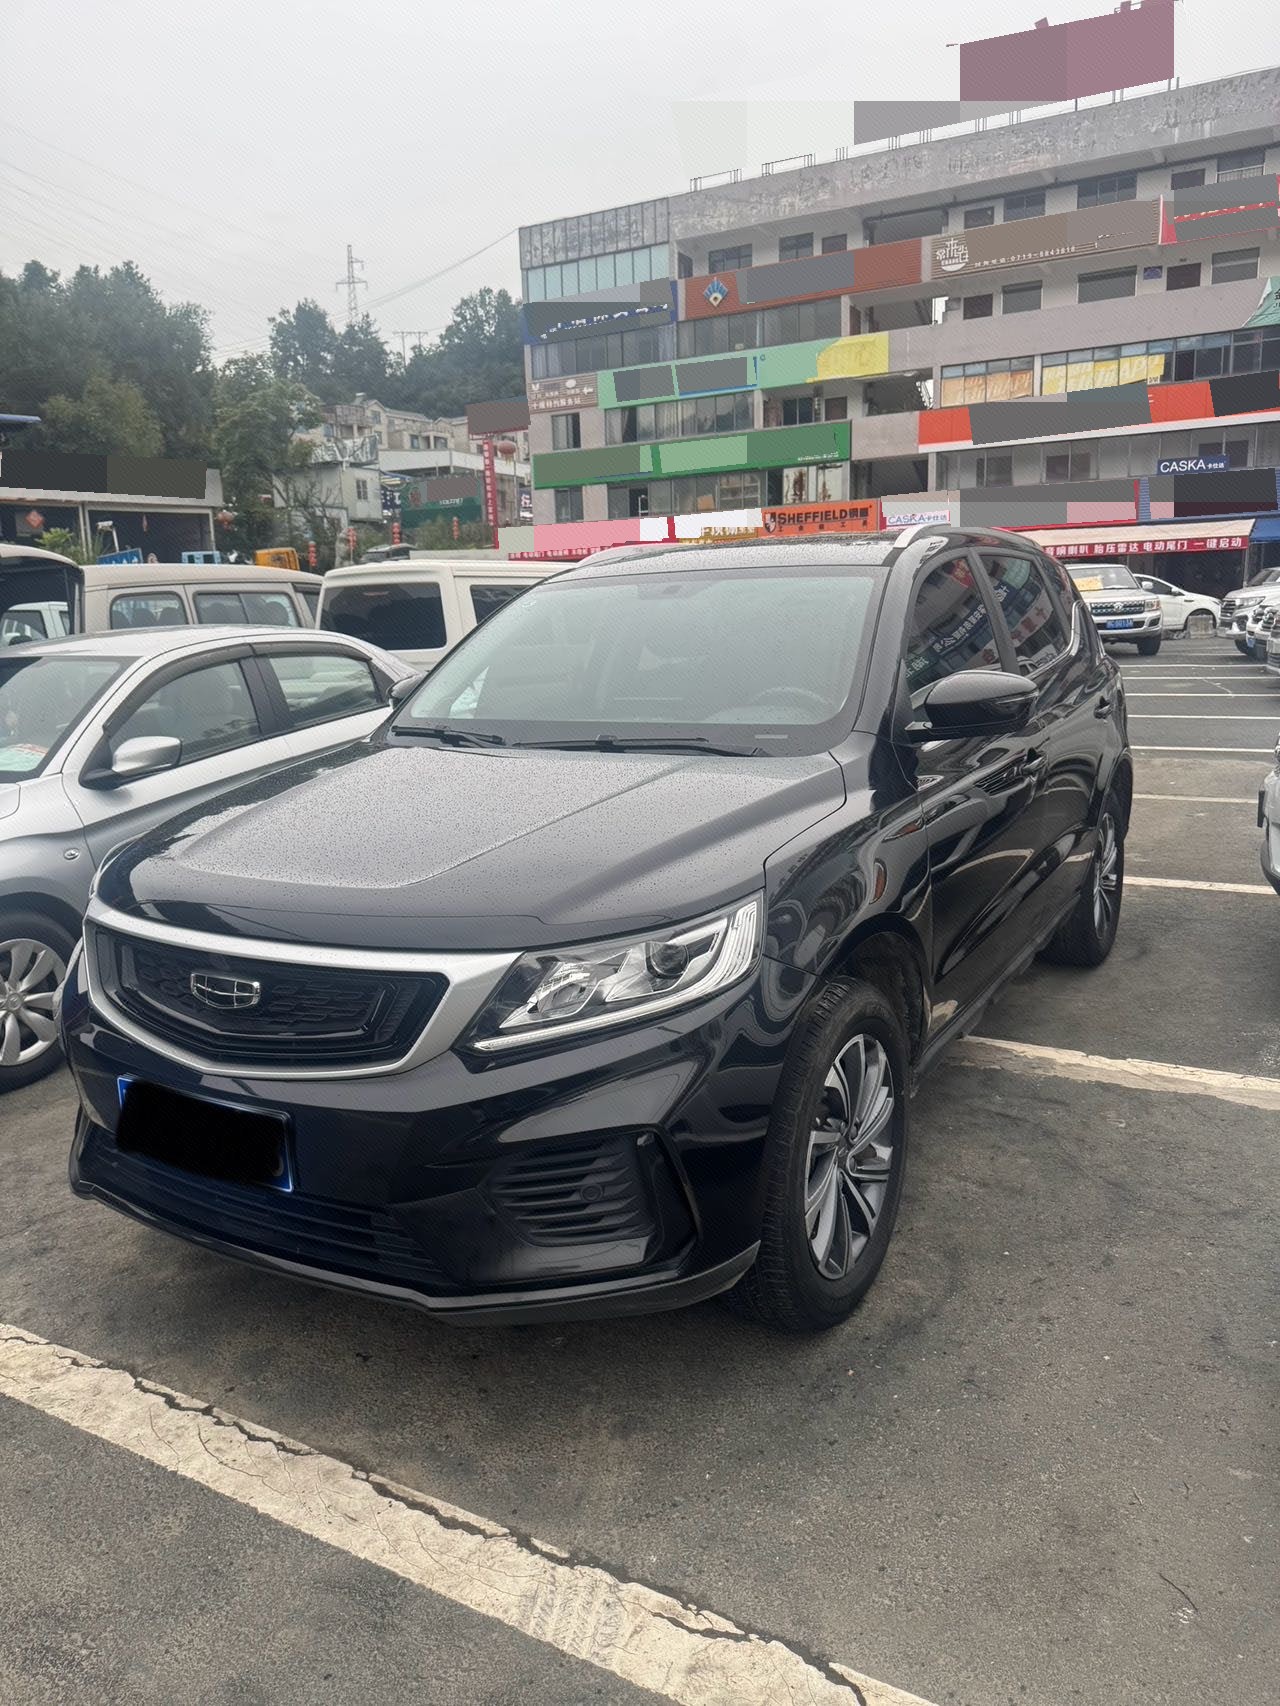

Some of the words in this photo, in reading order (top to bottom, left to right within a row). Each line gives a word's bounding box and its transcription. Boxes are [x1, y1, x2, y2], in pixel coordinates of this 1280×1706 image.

[1160, 459, 1206, 473] CASKA
[777, 508, 847, 525] SHEFFIELD
[888, 513, 925, 525] CASKA
[1094, 543, 1139, 554] 胎压雷达
[1143, 541, 1188, 552] 电动尾门
[1193, 537, 1242, 549] 一键启动
